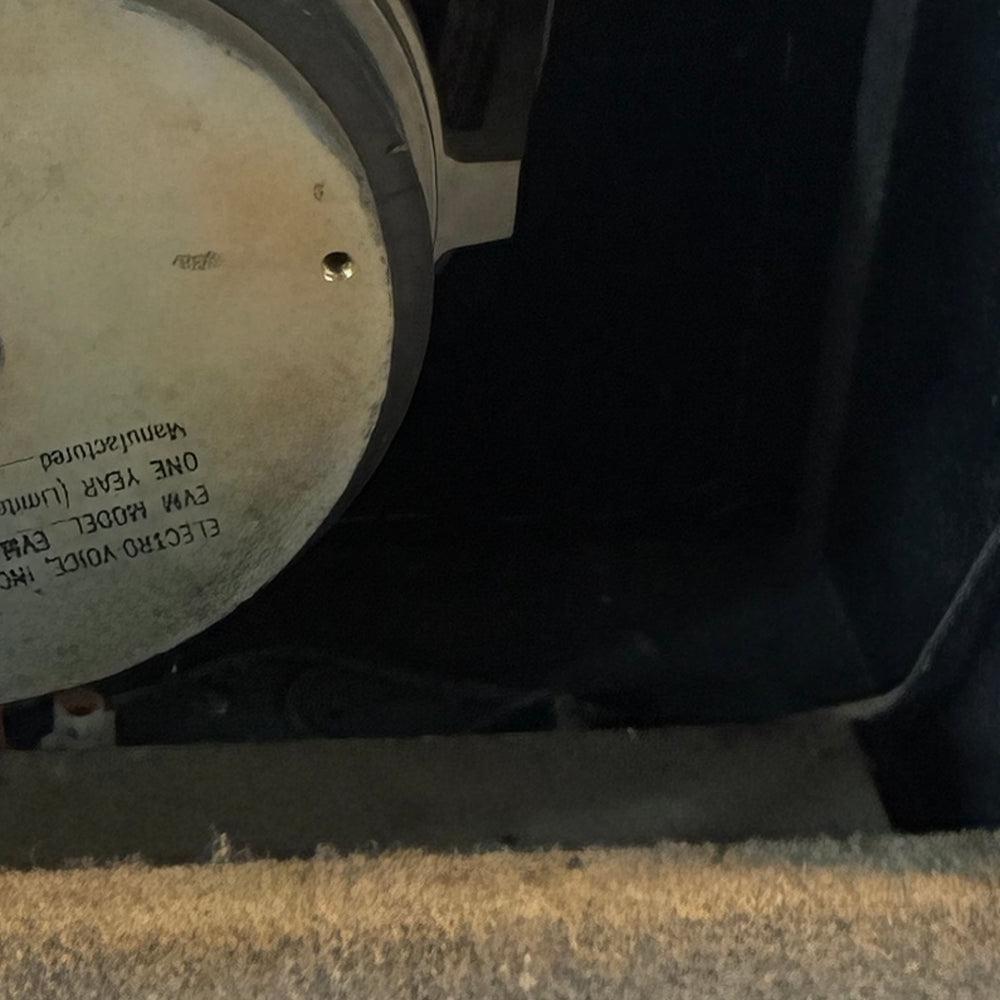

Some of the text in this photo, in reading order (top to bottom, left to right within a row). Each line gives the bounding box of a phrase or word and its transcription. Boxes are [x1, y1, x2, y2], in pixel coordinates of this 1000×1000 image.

[40, 422, 187, 472] Manufactured
[150, 451, 199, 480] ONE
[82, 467, 140, 497] YEAR
[162, 484, 210, 513] EVM
[76, 501, 148, 535] MODEL
[123, 517, 221, 558] ELECTRO
